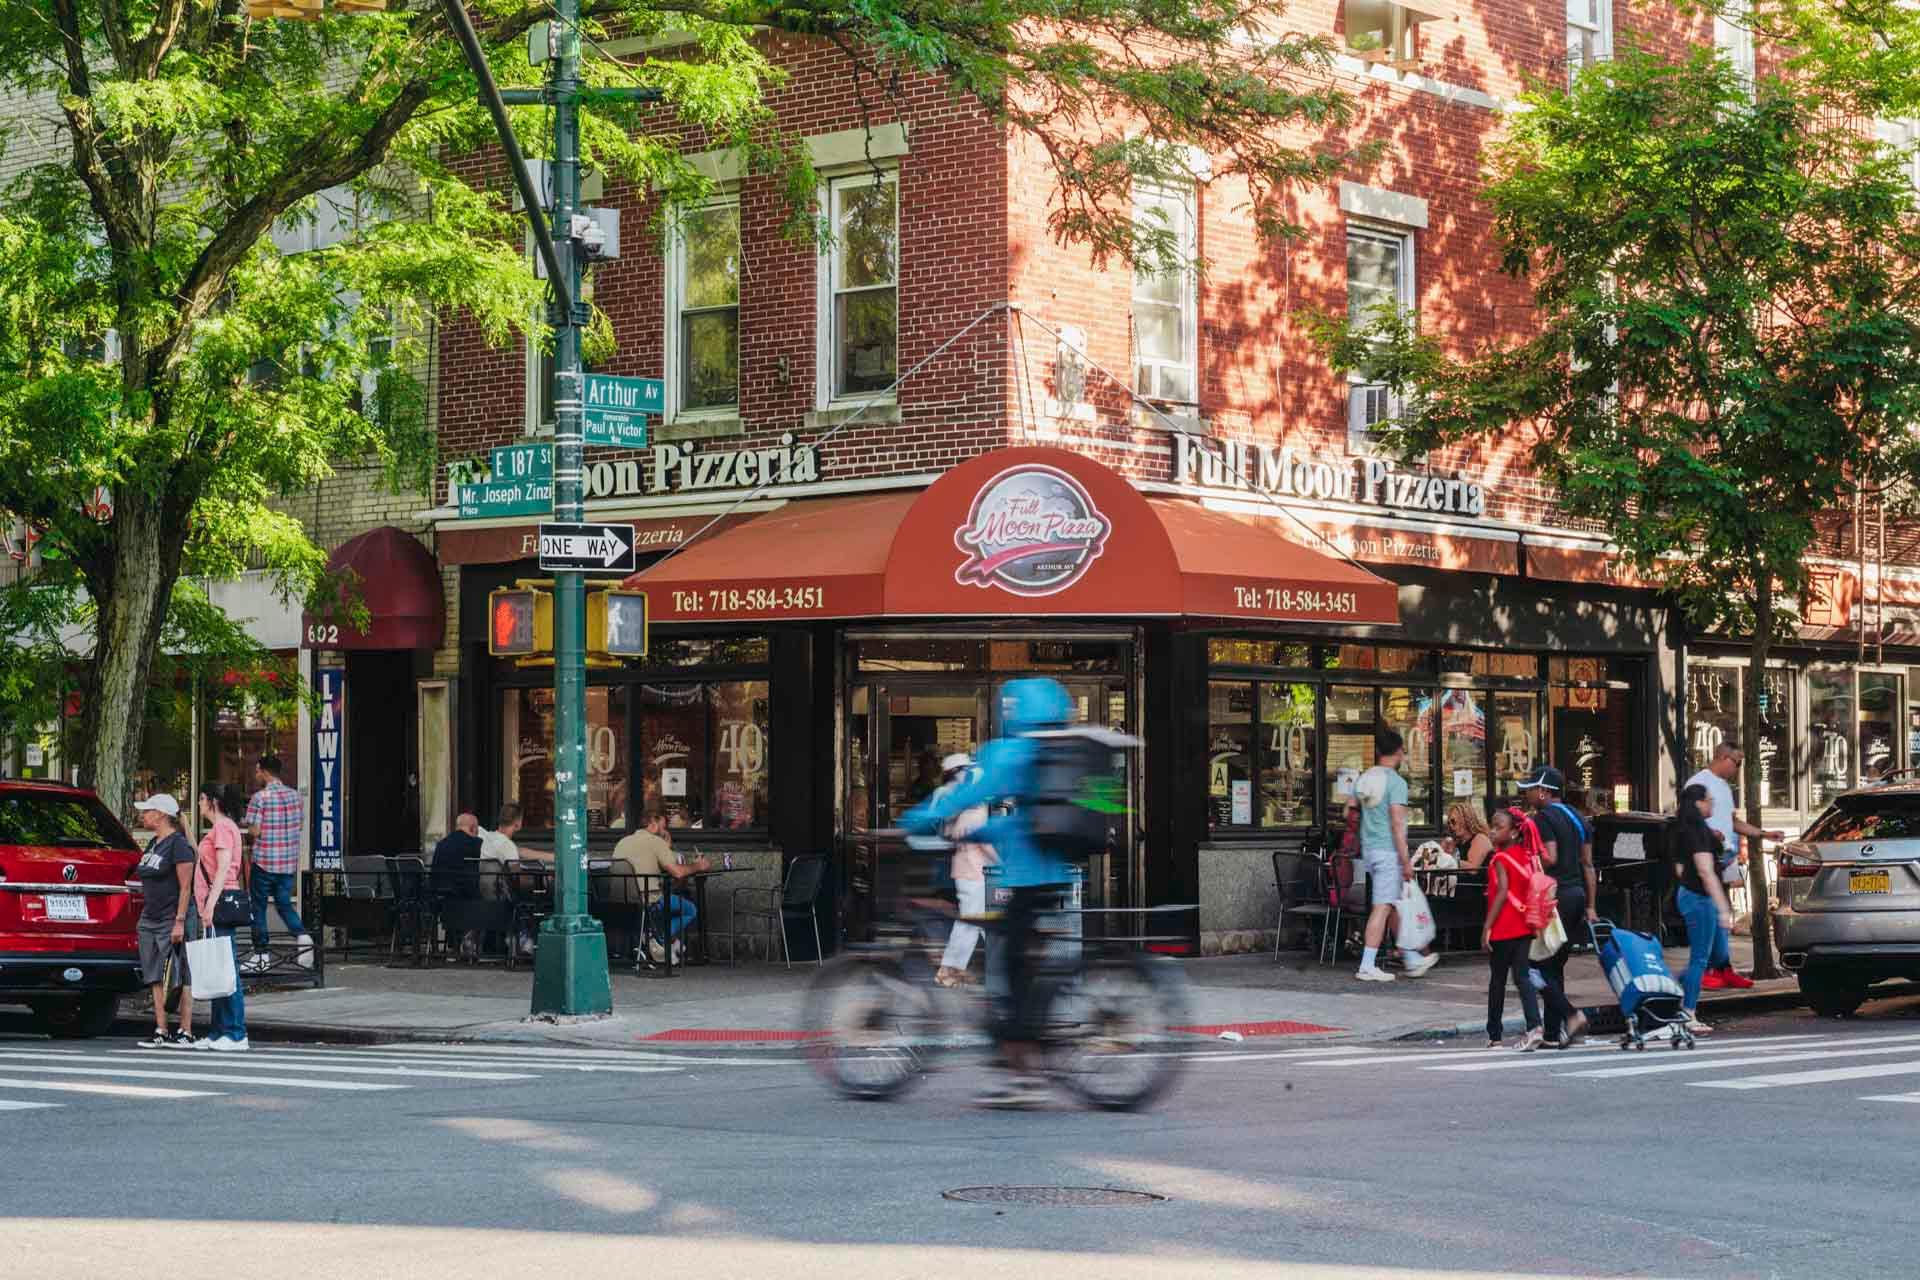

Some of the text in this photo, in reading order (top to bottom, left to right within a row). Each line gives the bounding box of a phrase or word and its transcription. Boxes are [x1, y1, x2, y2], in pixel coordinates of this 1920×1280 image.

[588, 379, 639, 407] Arthur
[586, 419, 642, 437] Paul A Victor
[496, 448, 551, 477] E 187 St
[651, 433, 819, 492] Pizzeria
[1174, 433, 1485, 514] Full Moon Pizzeria
[462, 487, 478, 505] Mr.
[482, 484, 521, 505] Joseph
[525, 482, 553, 501] Zinzi
[1007, 497, 1041, 515] Full
[520, 525, 684, 553] Fu zzeria
[971, 511, 1097, 542] Moon Pizza
[543, 538, 618, 555] ONE WAY
[1382, 536, 1440, 560] Pizzeria
[672, 587, 824, 612] Tel: 718-584-3451
[1234, 586, 1357, 613] Tel: 718-584-3451
[307, 625, 338, 644] 602
[317, 673, 338, 847] LAWYER
[720, 725, 762, 773] 40
[1271, 725, 1305, 769] 40
[1214, 768, 1225, 785] A
